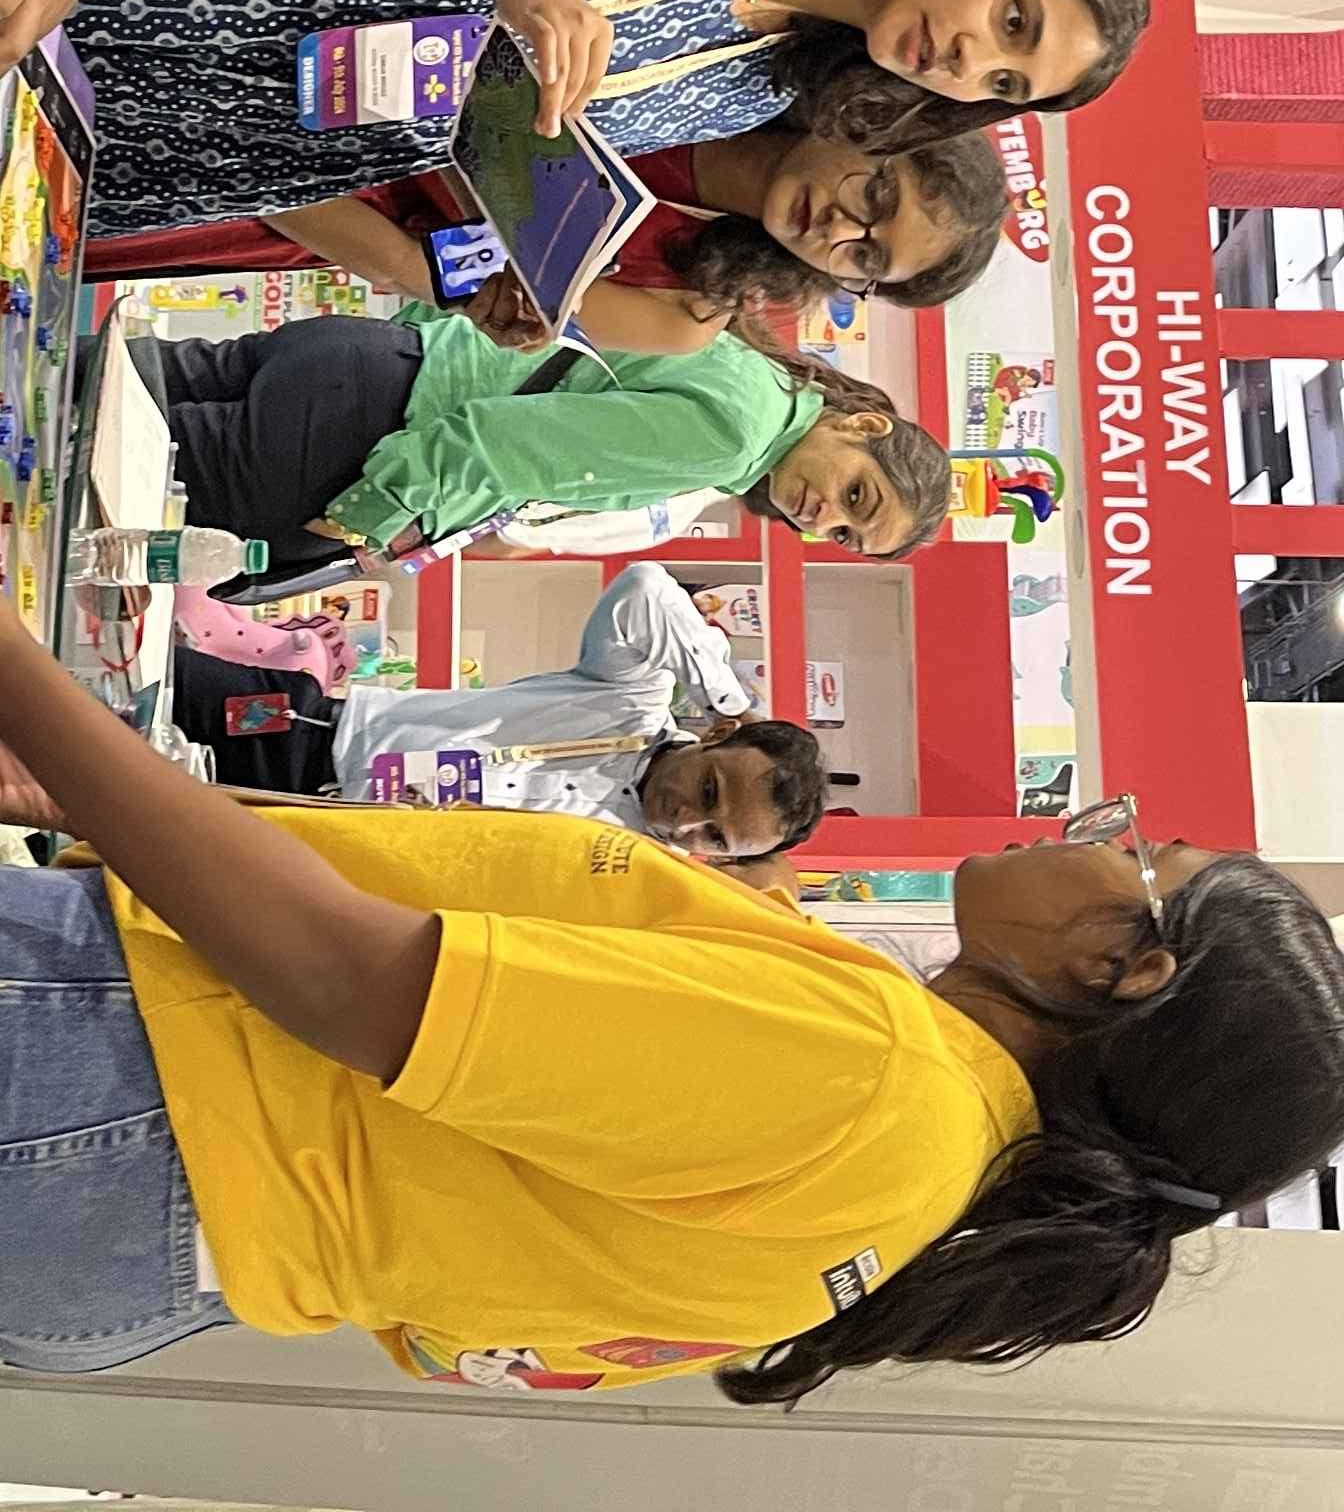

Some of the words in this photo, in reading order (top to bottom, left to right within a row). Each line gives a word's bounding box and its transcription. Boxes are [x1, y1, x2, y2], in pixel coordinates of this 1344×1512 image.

[302, 56, 315, 116] DESIGNER
[995, 119, 1050, 249] TEMBURG
[283, 302, 293, 324] PLA
[1084, 185, 1152, 594] CORPORATION
[1156, 291, 1211, 486] HI-WAY
[1015, 410, 1027, 449] Swing
[1026, 411, 1038, 438] Baby
[747, 589, 762, 634] CRICKET
